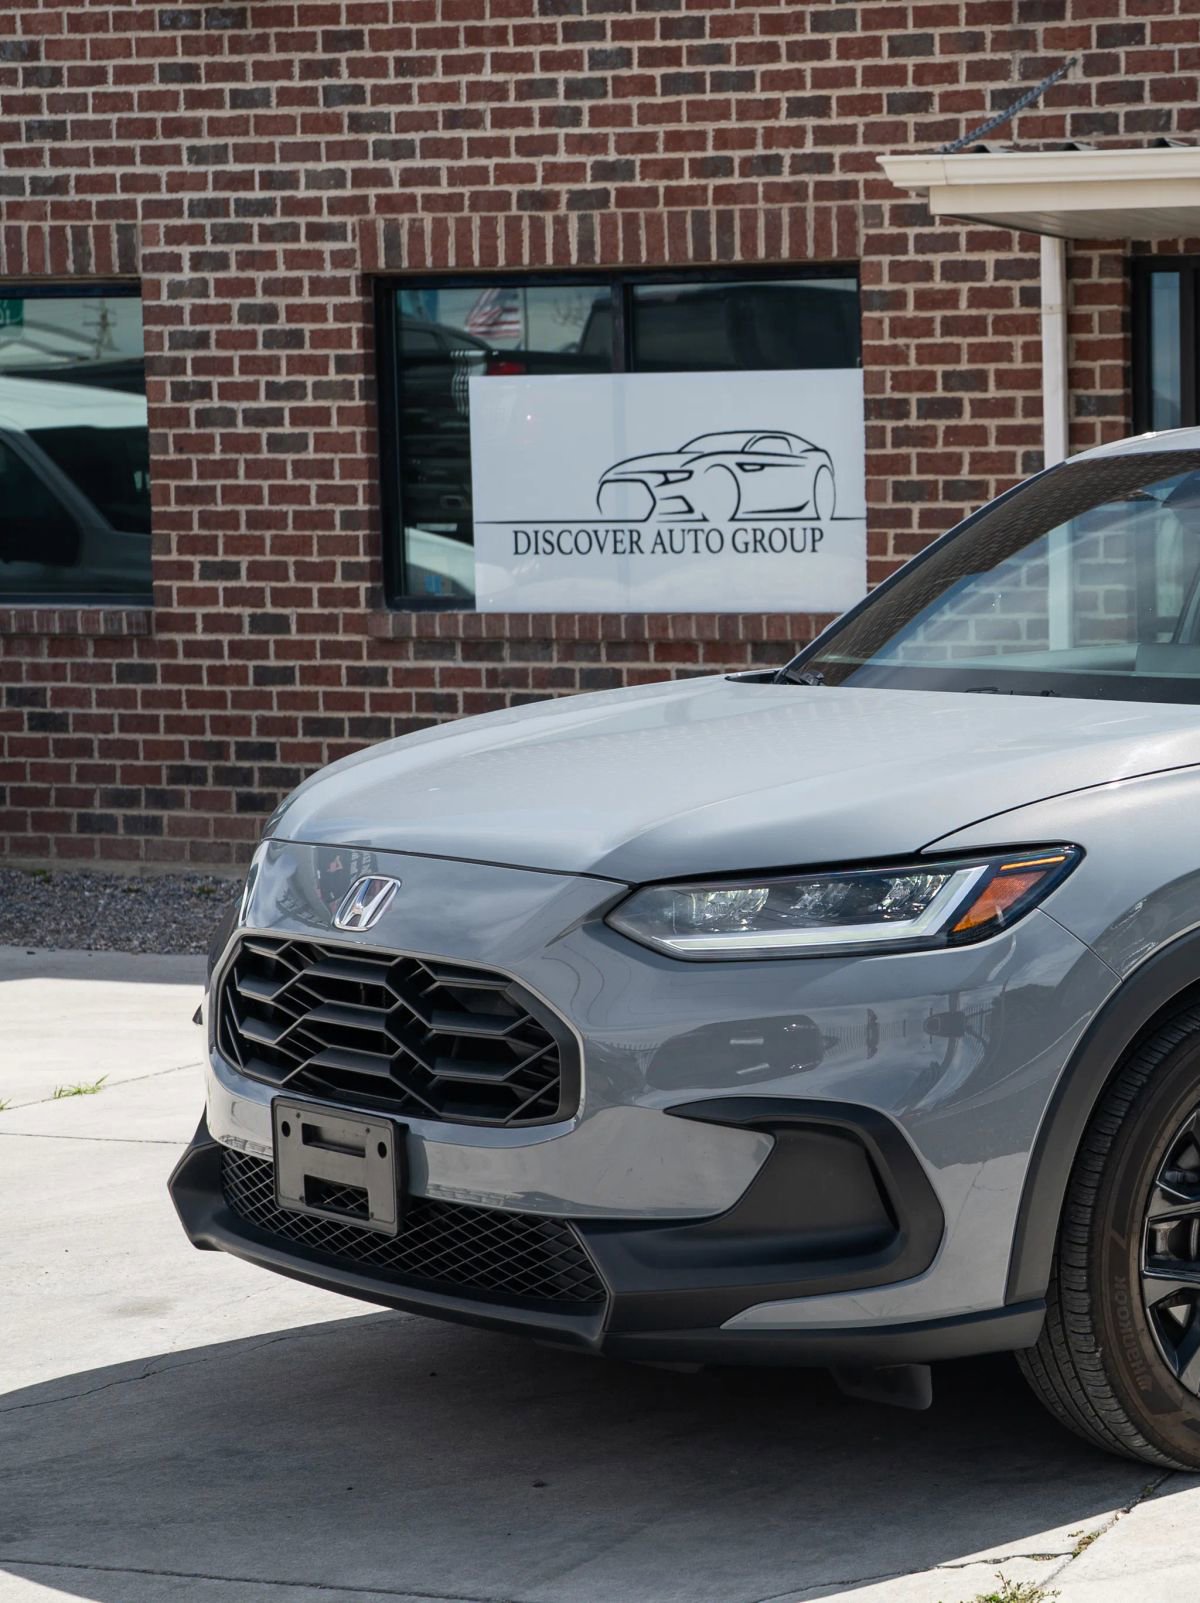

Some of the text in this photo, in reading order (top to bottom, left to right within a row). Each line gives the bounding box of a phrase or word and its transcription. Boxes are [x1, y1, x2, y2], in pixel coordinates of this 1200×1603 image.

[513, 527, 824, 556] DISCOVER AUTO GROUP
